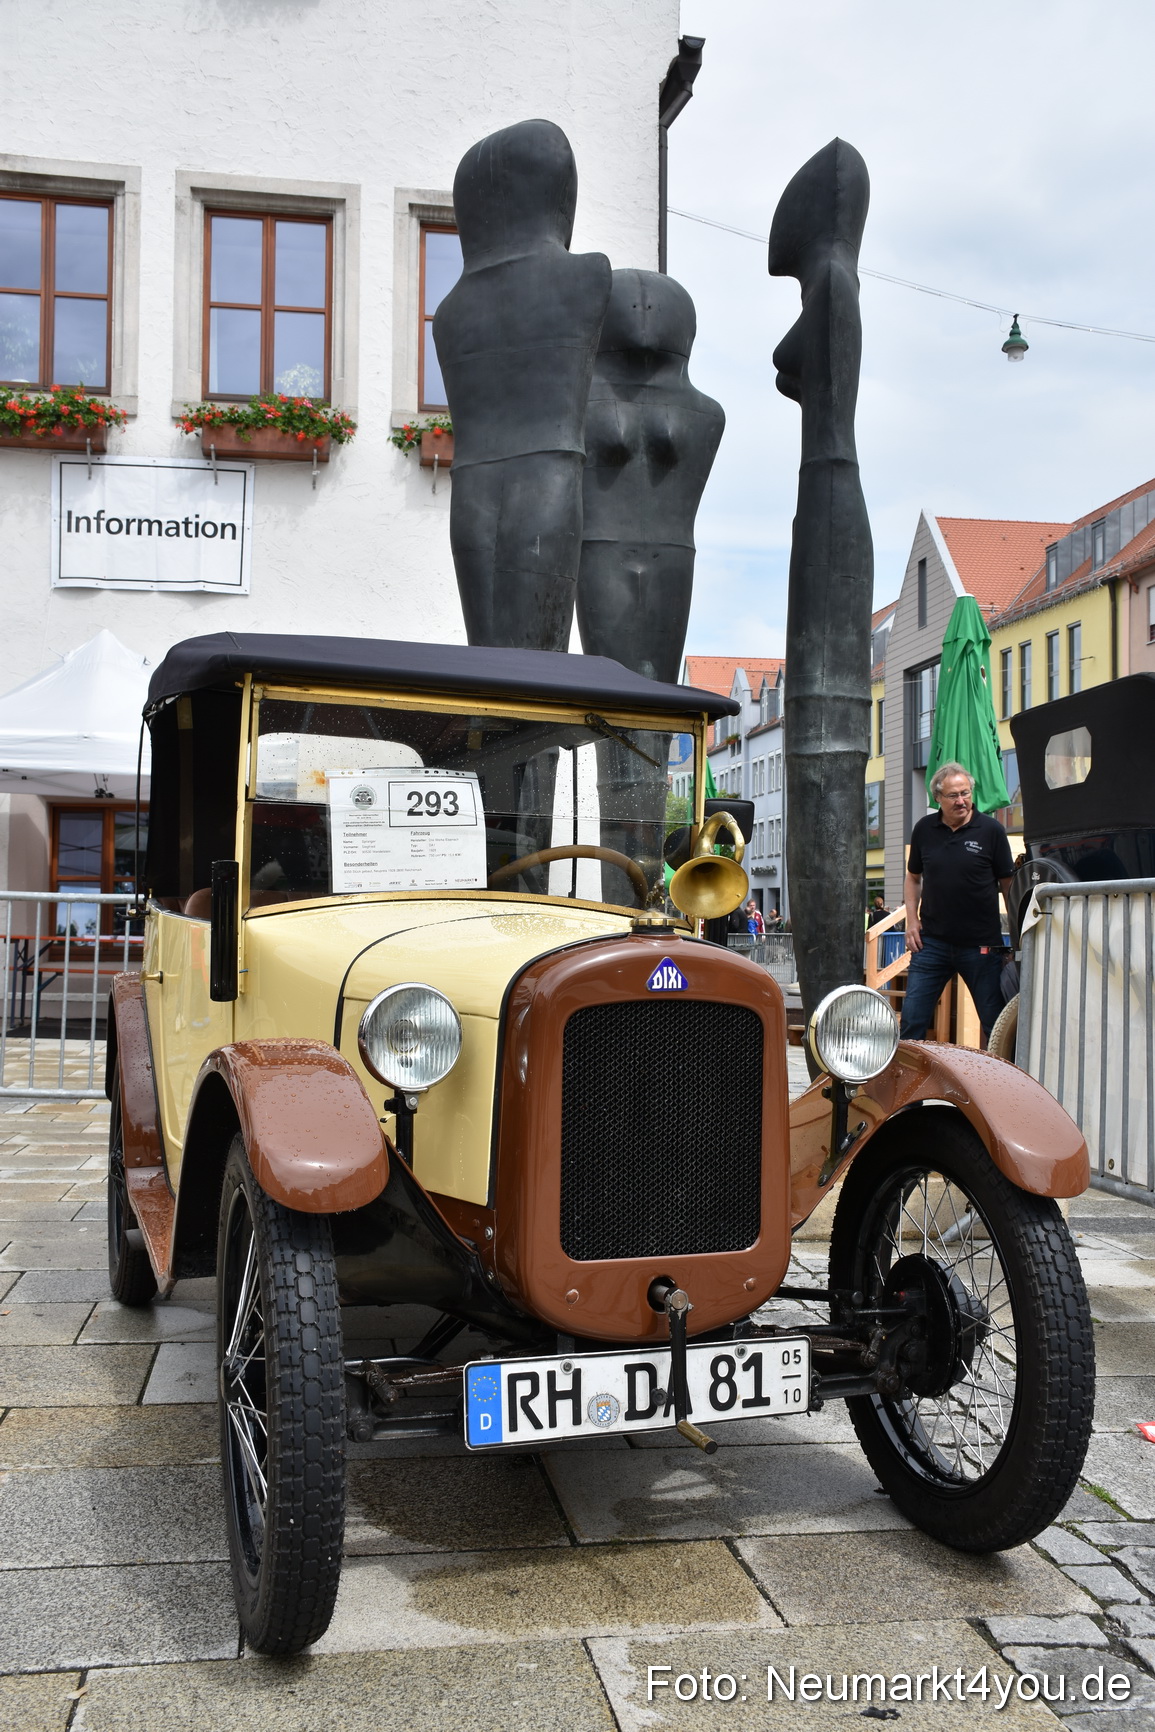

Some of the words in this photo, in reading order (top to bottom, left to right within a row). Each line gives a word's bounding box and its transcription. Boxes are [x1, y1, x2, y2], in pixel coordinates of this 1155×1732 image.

[66, 510, 237, 540] Information
[406, 790, 460, 817] 293
[651, 966, 682, 989] DIXI
[780, 1348, 802, 1365] 05
[507, 1367, 582, 1433] RH
[708, 1351, 771, 1412] 81
[783, 1387, 802, 1404] 10
[479, 1412, 492, 1431] D
